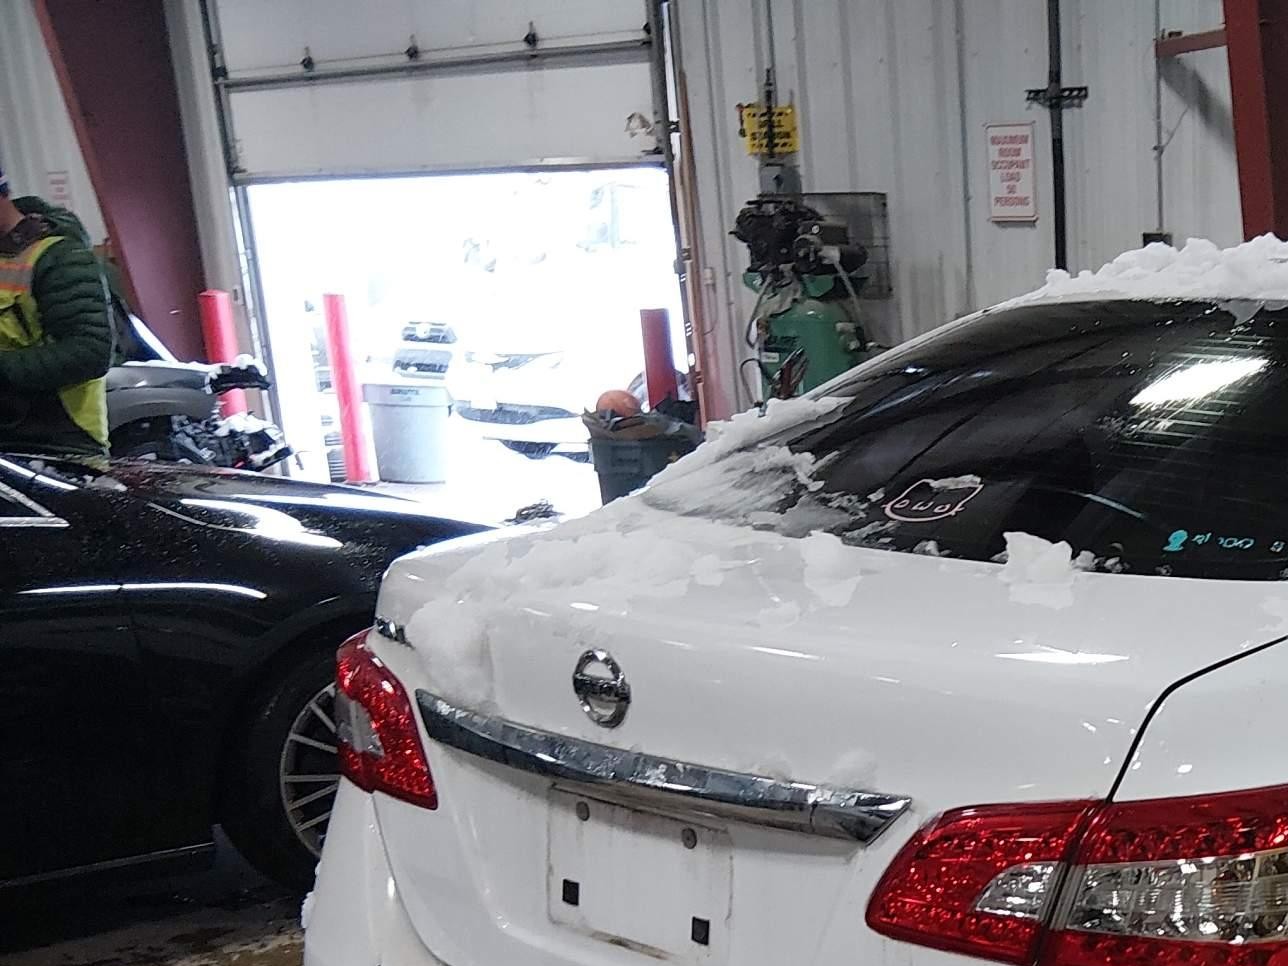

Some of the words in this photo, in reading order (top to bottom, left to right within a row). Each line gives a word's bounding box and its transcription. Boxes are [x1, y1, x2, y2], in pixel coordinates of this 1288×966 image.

[990, 134, 1029, 145] MAXIMUM
[998, 147, 1022, 157] ROOM
[991, 159, 1030, 170] OCCUPANT
[1000, 171, 1021, 182] LOAD
[993, 196, 1030, 207] PERSONS
